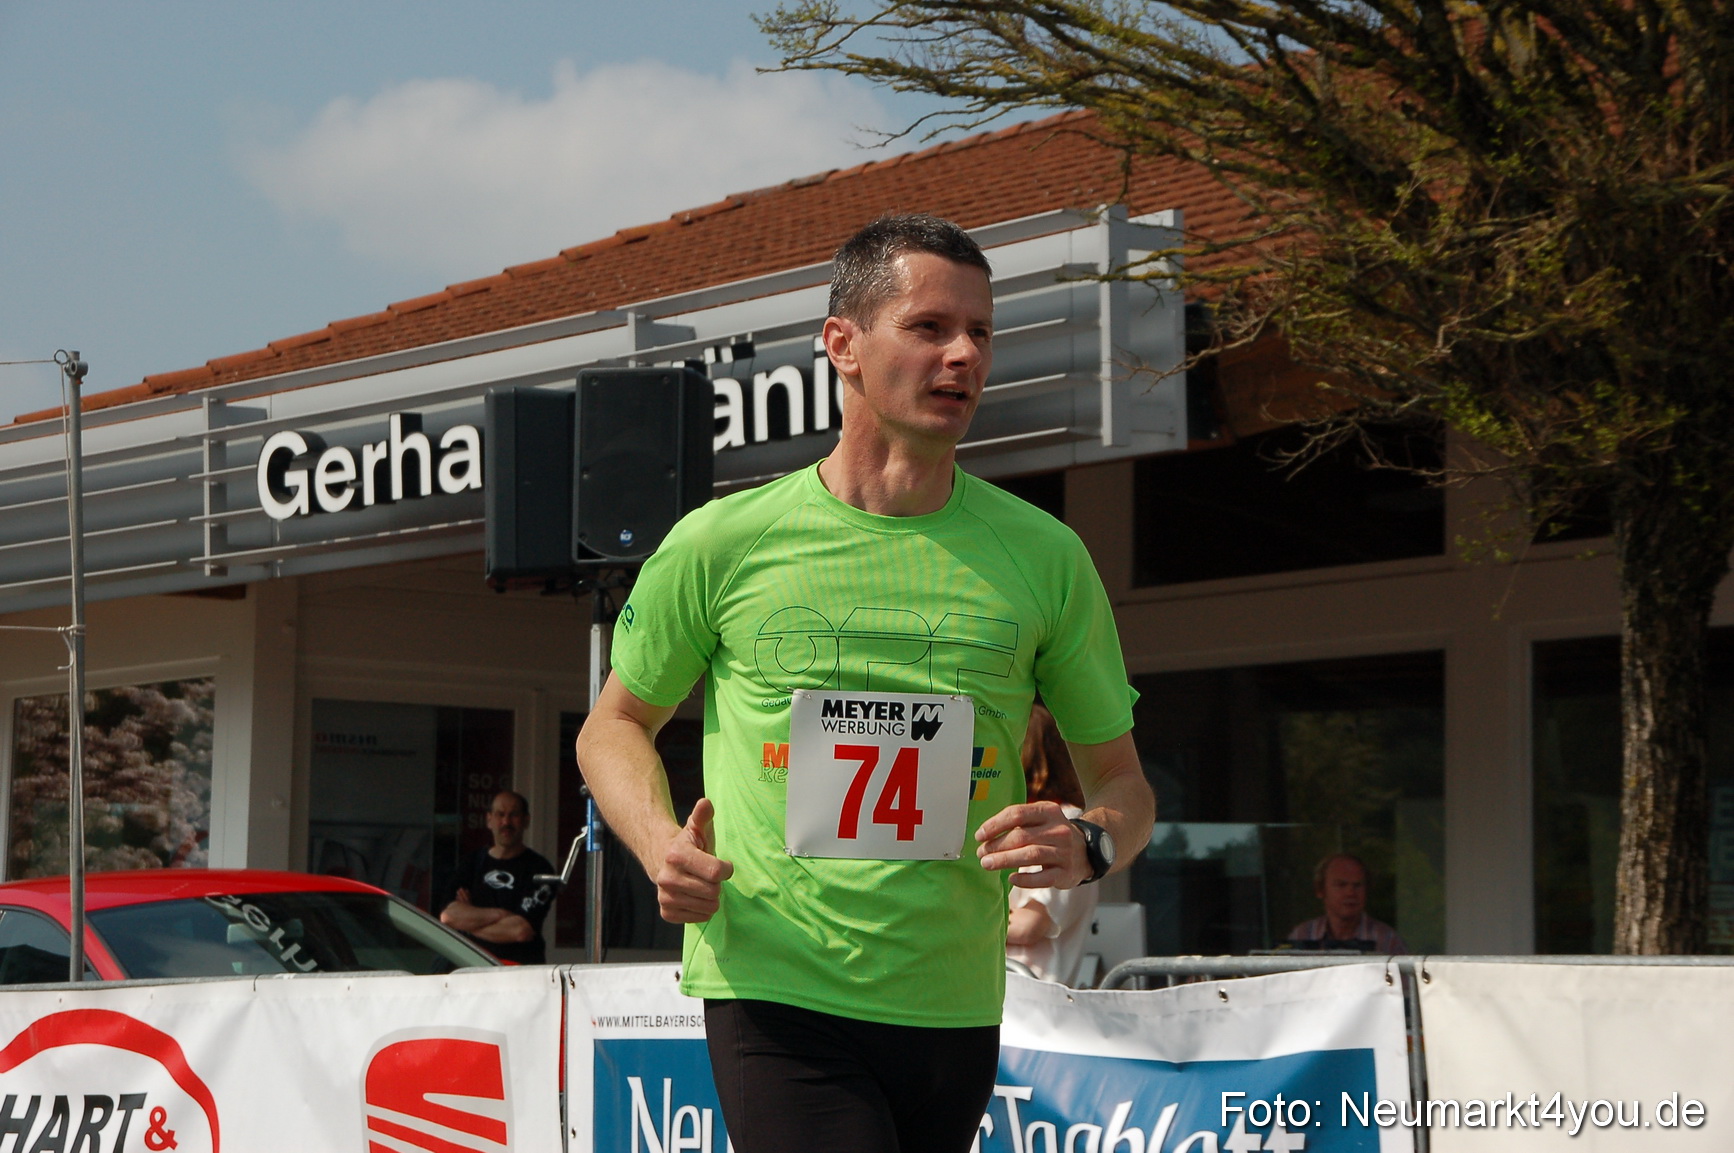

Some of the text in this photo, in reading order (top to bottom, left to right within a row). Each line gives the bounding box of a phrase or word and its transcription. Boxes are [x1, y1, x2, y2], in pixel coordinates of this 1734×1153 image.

[257, 335, 844, 520] Gerha äni
[821, 699, 906, 721] MEYER
[821, 719, 906, 736] WERBUNG
[834, 744, 924, 841] 74
[144, 1106, 178, 1152] &
